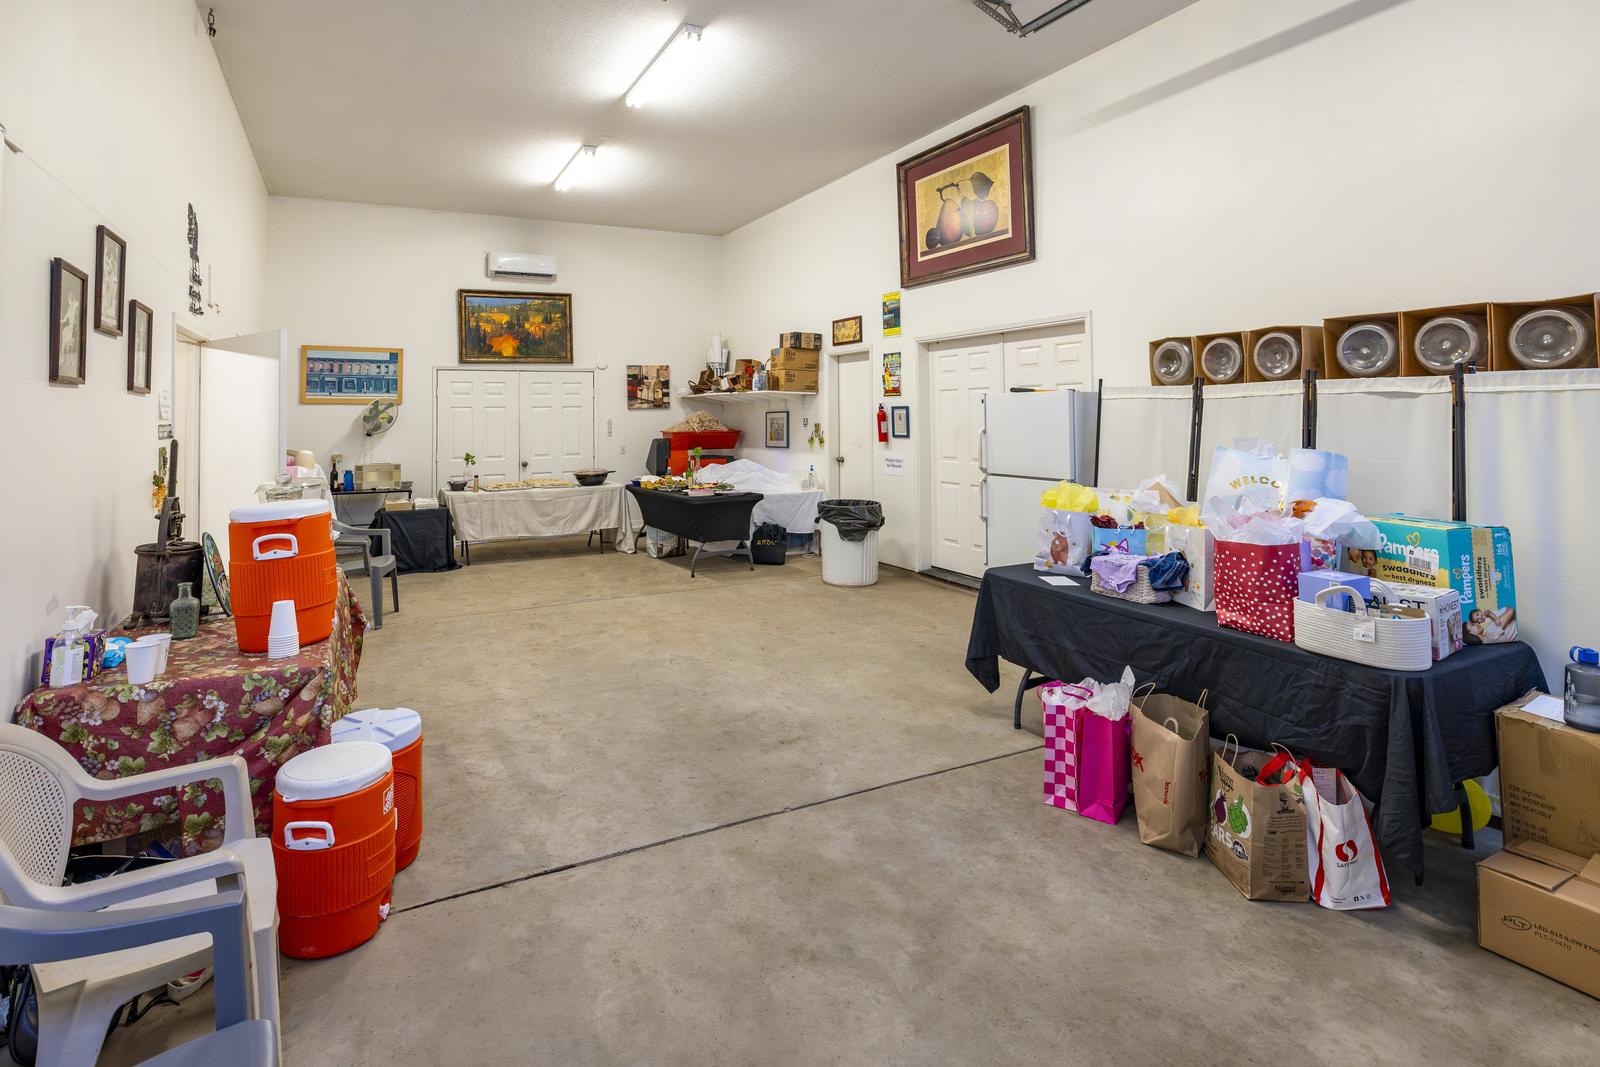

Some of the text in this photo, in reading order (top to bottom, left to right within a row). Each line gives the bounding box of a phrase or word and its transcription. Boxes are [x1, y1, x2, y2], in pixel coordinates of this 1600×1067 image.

[1229, 475, 1280, 490] WELCO
[1391, 573, 1406, 582] best
[1407, 576, 1436, 587] dryness
[1459, 554, 1473, 604] Pampers
[1476, 556, 1485, 600] swaddlers
[1503, 915, 1527, 929] PLT
